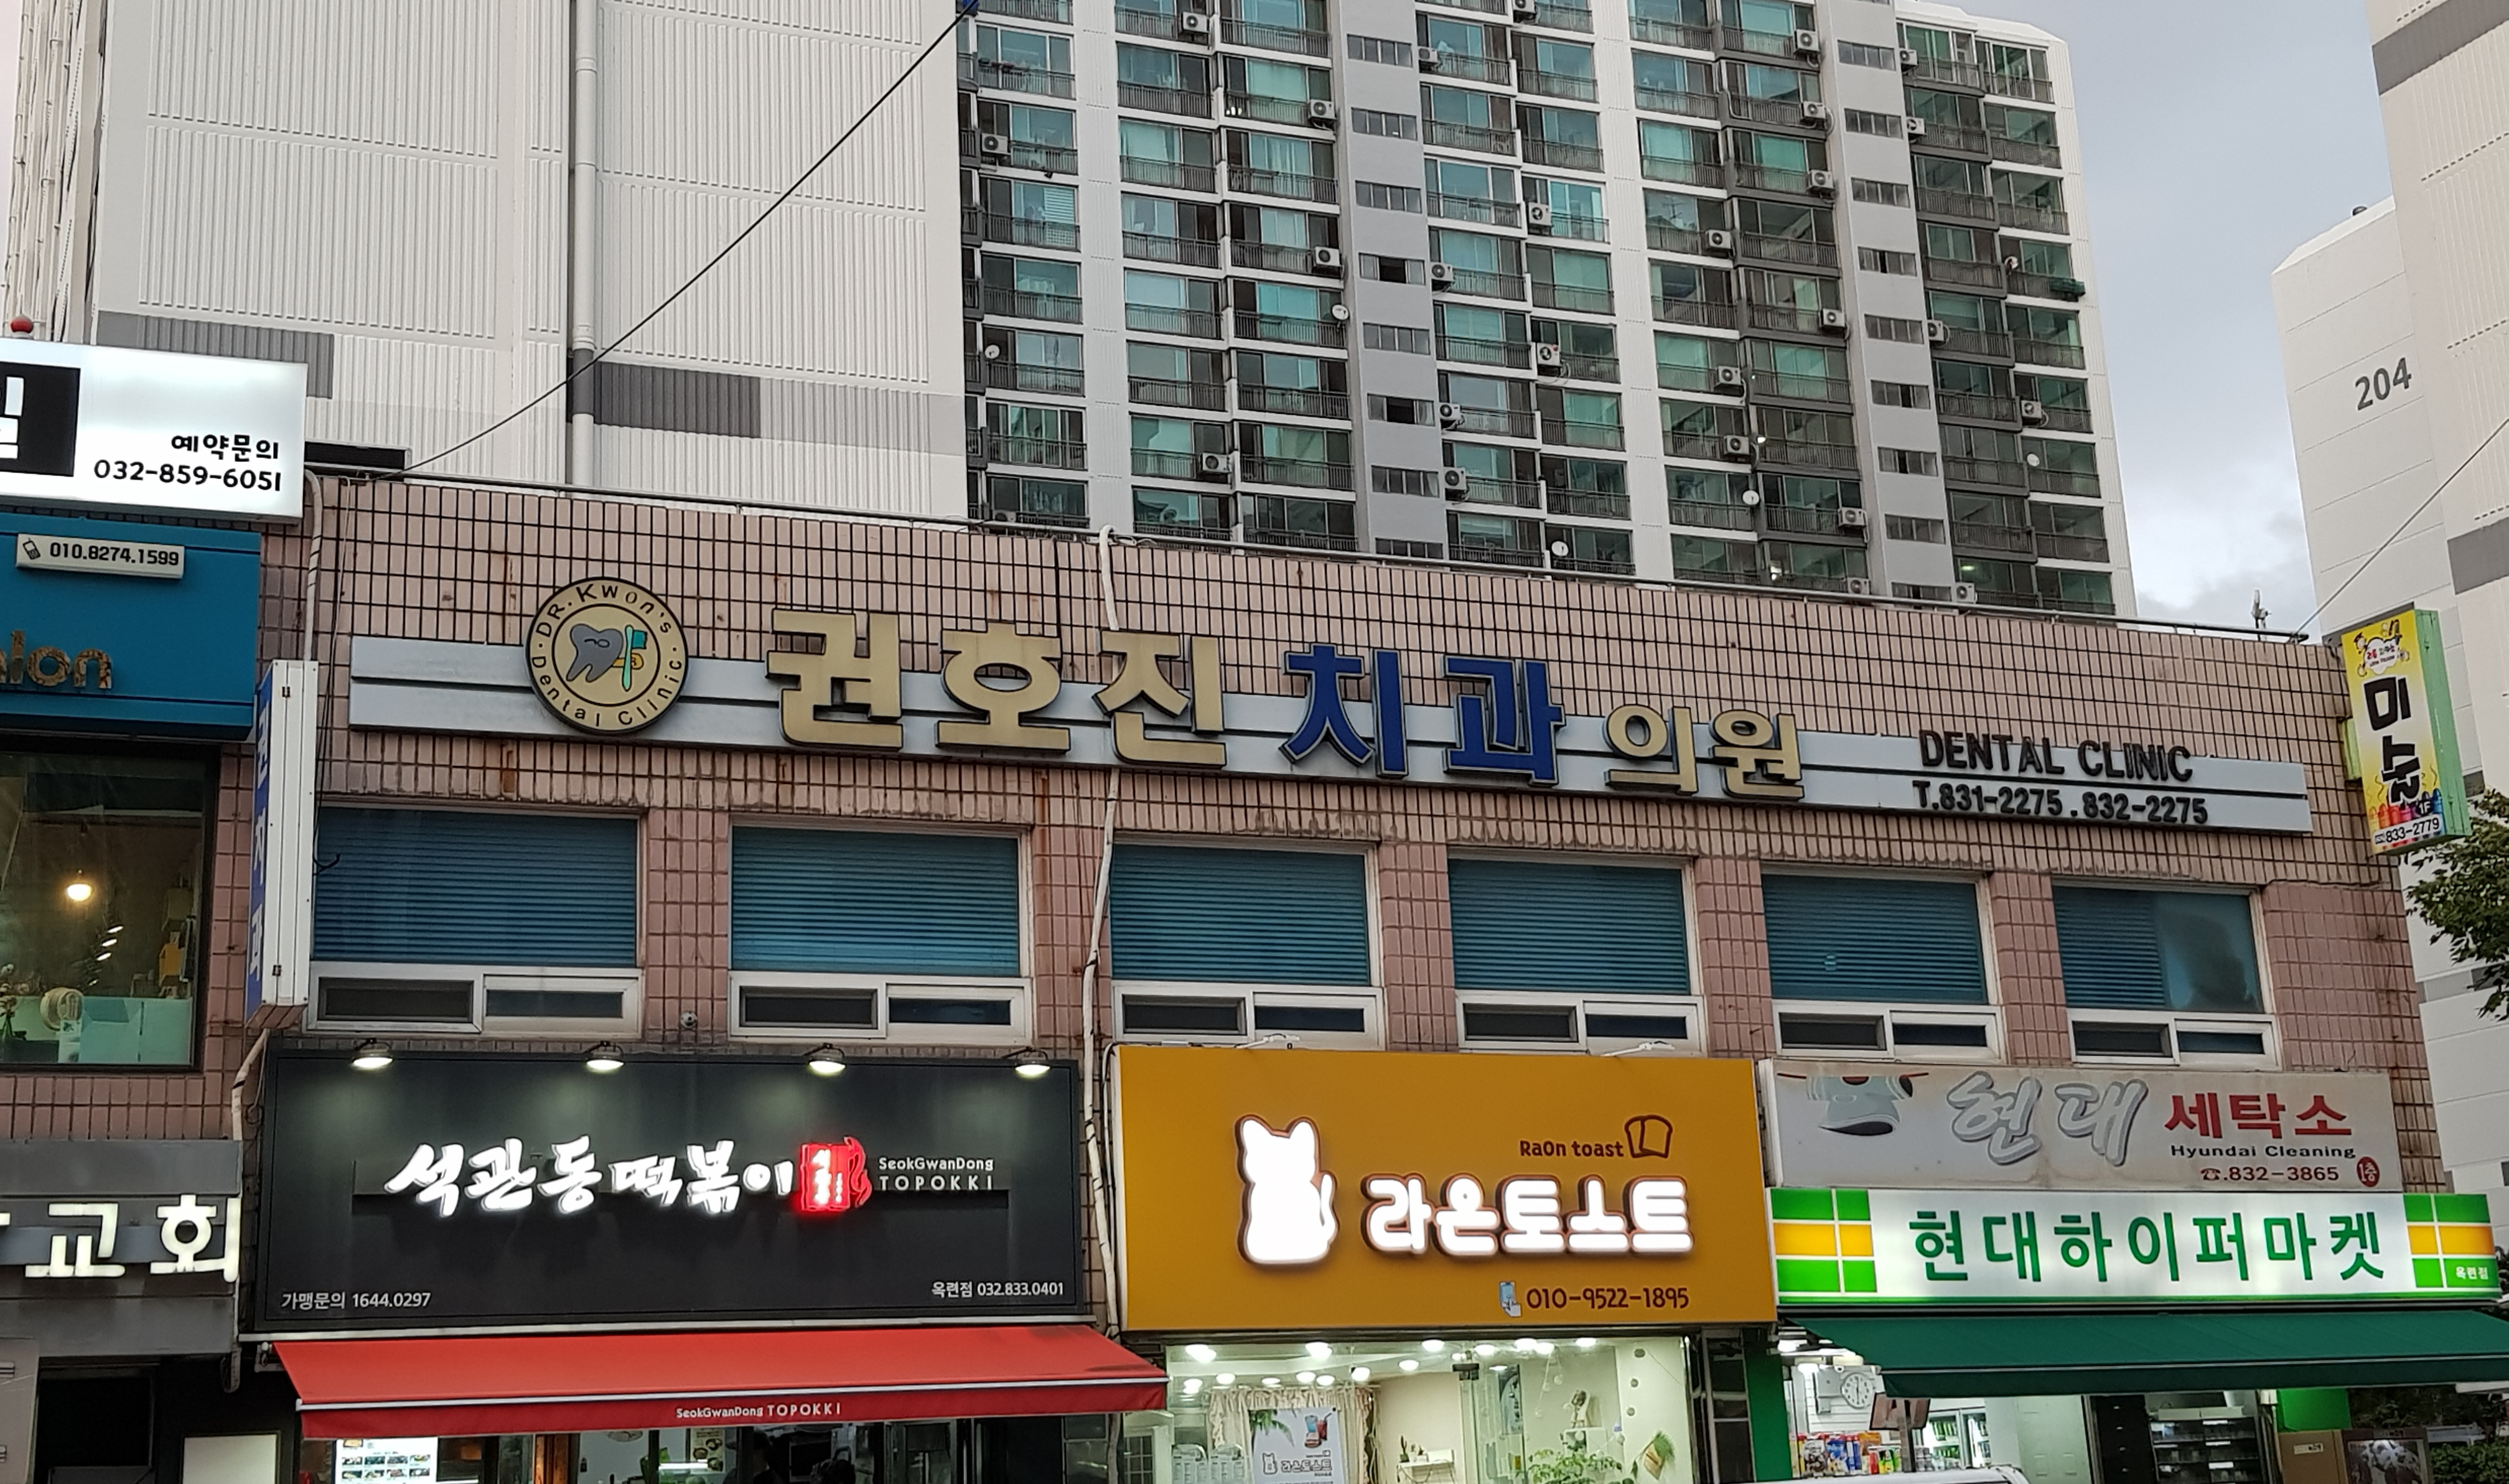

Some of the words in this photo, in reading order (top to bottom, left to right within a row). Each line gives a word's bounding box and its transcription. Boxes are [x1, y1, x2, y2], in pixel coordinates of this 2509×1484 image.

[2355, 357, 2412, 411] 204
[171, 434, 279, 462] 예약문의
[94, 459, 281, 492] 032-859-6051
[49, 542, 179, 567] 010.8274.1599
[0, 629, 112, 689] lon
[531, 656, 600, 727] Dental
[618, 660, 682, 725] Clinic
[766, 607, 1227, 767] 권호진
[1279, 642, 1566, 788] 치과
[2364, 677, 2420, 803] 미술
[1919, 729, 2065, 775] DENTAL
[2078, 740, 2193, 782] CLINIC
[2419, 800, 2431, 814] 1F
[2386, 817, 2439, 843] 833-2779
[1946, 1070, 2149, 1167] 현대
[2164, 1092, 2352, 1139] 세탁소
[1571, 1141, 1624, 1158] toast
[2170, 1145, 2256, 1158] Hyundai
[2265, 1145, 2357, 1159] Cleaning
[879, 1156, 994, 1172] SeokGwanDong
[2358, 1162, 2378, 1182] 1층
[879, 1175, 993, 1191] TOPOKKI
[1363, 1174, 1693, 1256] 라온토스트
[0, 1194, 241, 1282] 교회
[1909, 1210, 2385, 1282] 현대하이퍼마켓
[281, 1291, 346, 1310] 가맹문의
[352, 1292, 431, 1307] 1644.0297
[932, 1281, 973, 1299] 옥련점
[977, 1281, 1064, 1297] 032.833.0401
[1526, 1287, 1689, 1310] 010-9522-1895
[676, 1406, 764, 1419] SeokGwanDong
[767, 1402, 841, 1417] TOPOKKI
